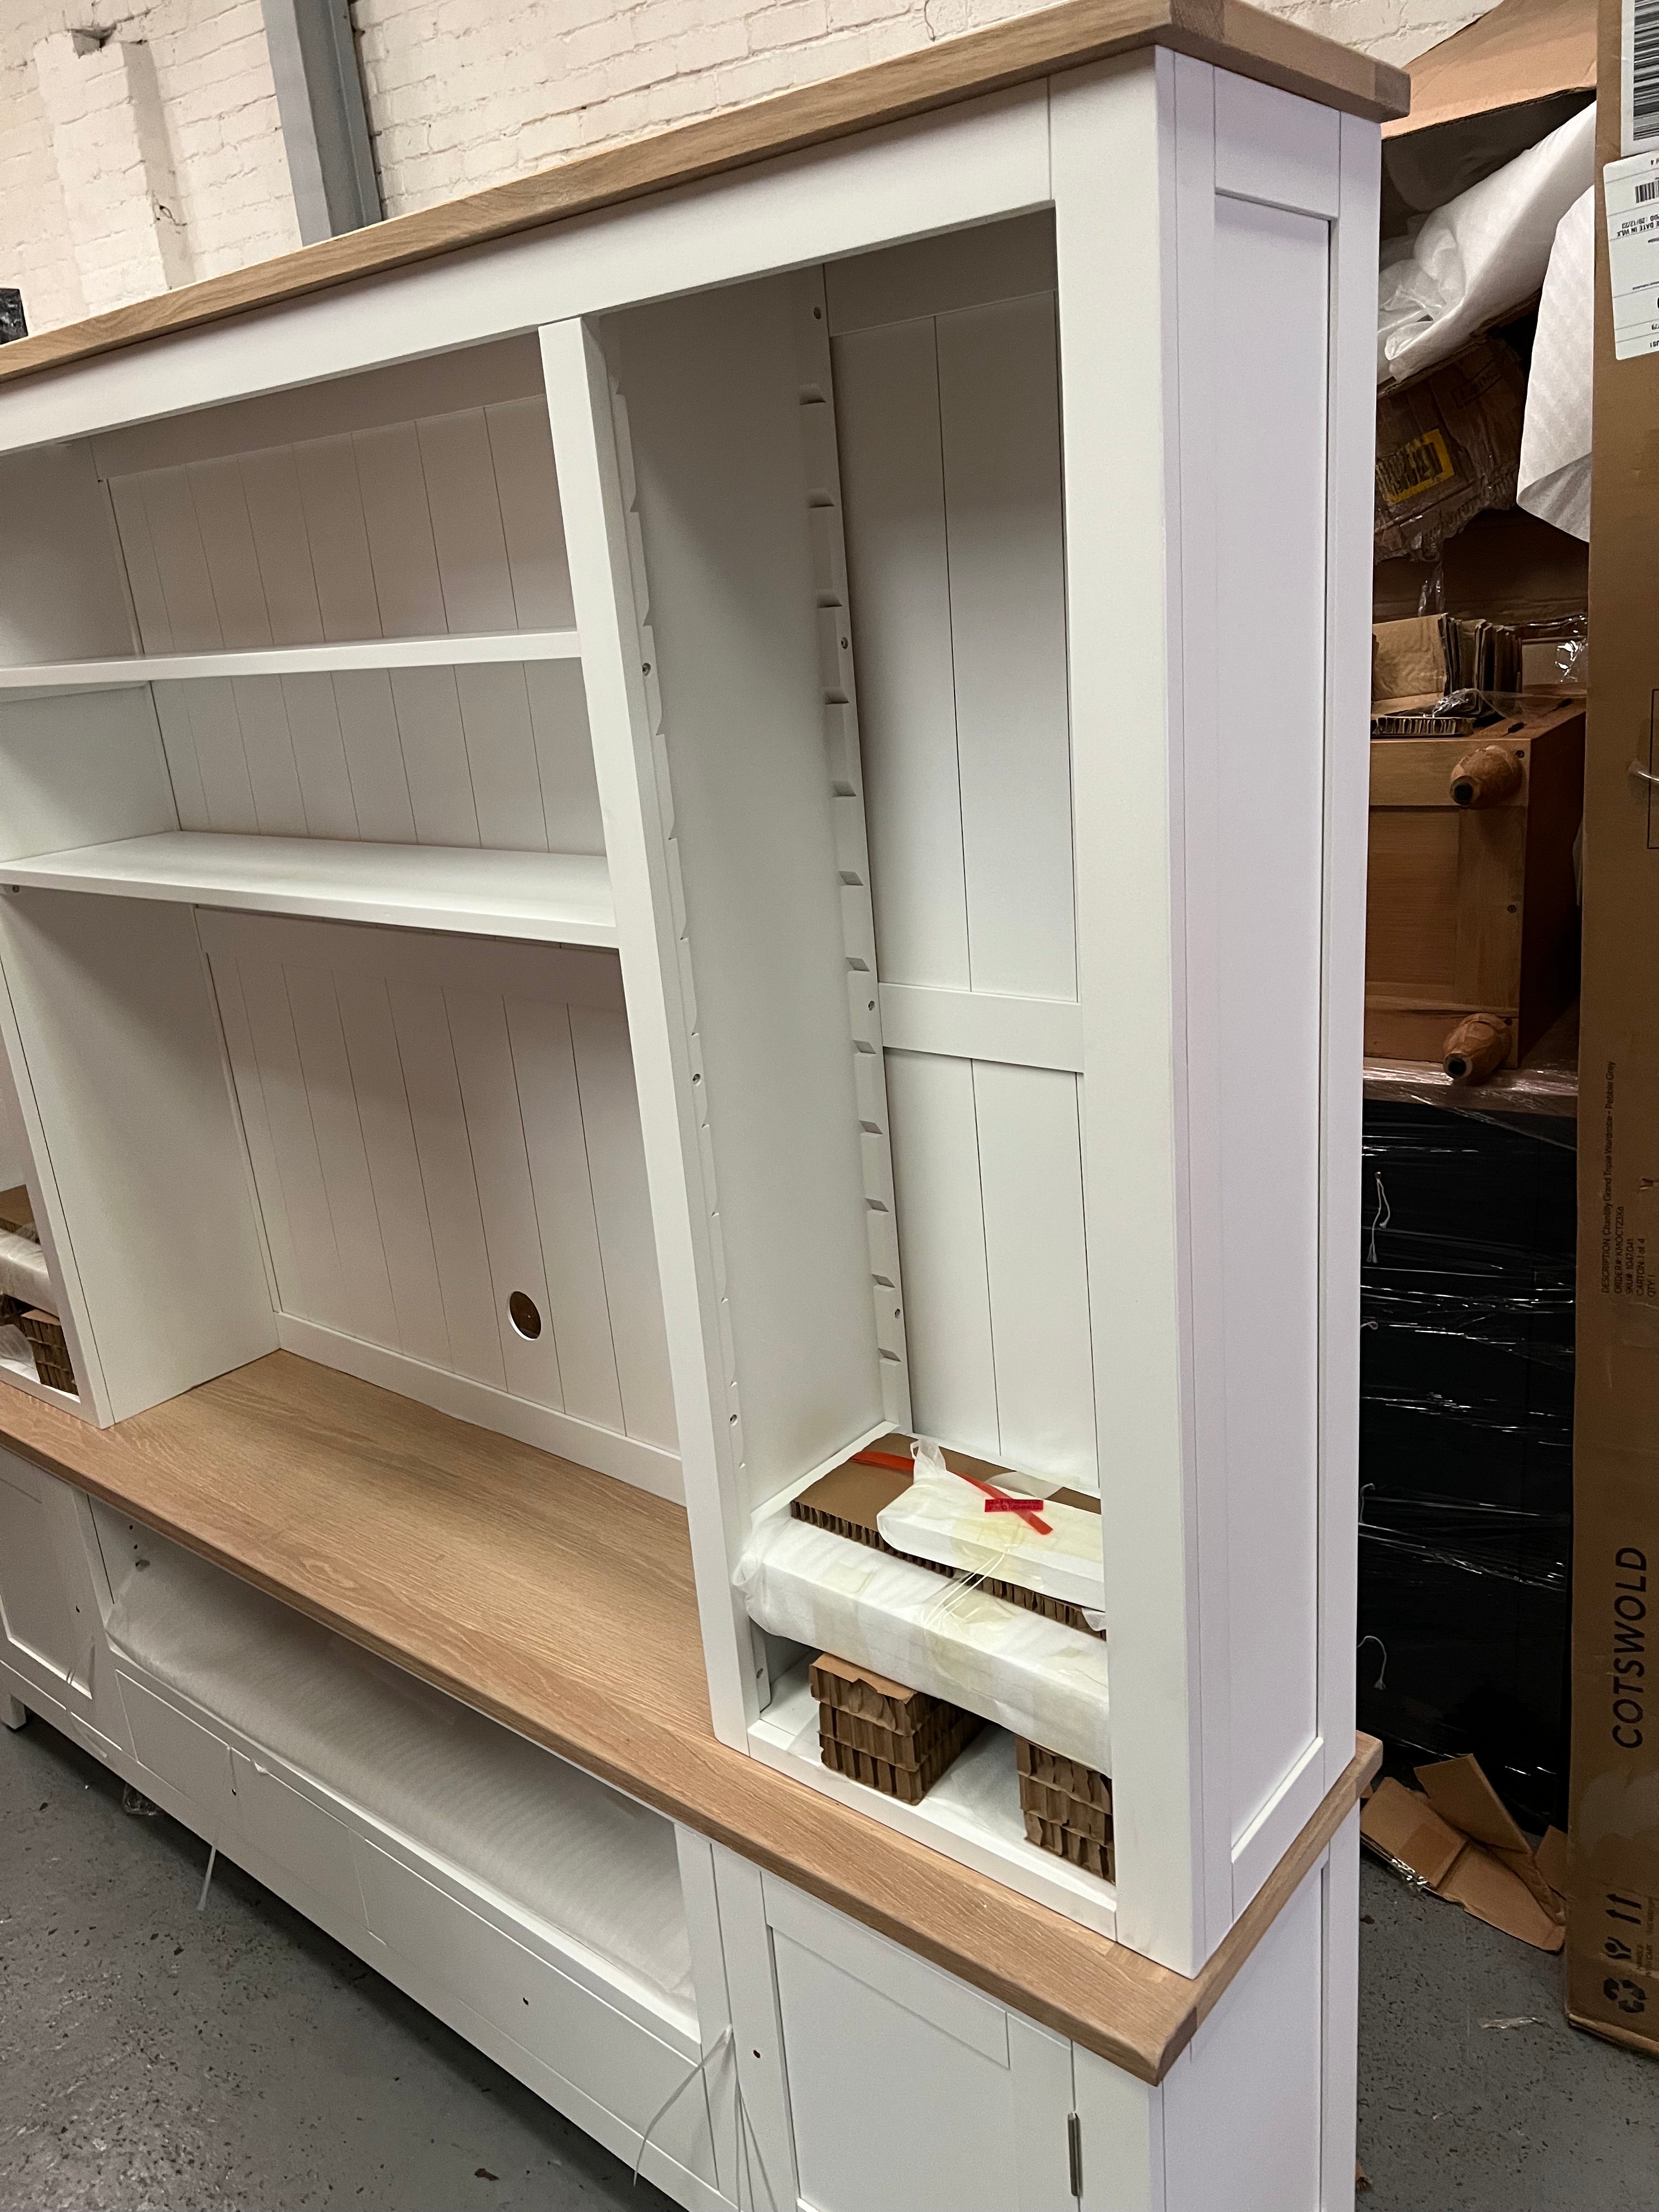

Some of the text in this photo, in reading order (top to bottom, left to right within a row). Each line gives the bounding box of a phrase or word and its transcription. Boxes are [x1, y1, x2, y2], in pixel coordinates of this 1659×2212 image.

[1639, 222, 1654, 232] DATE
[1605, 1115, 1613, 1154] Wardrobe
[1603, 1178, 1612, 1201] Grand
[1611, 1547, 1647, 1749] COTSWOLD
